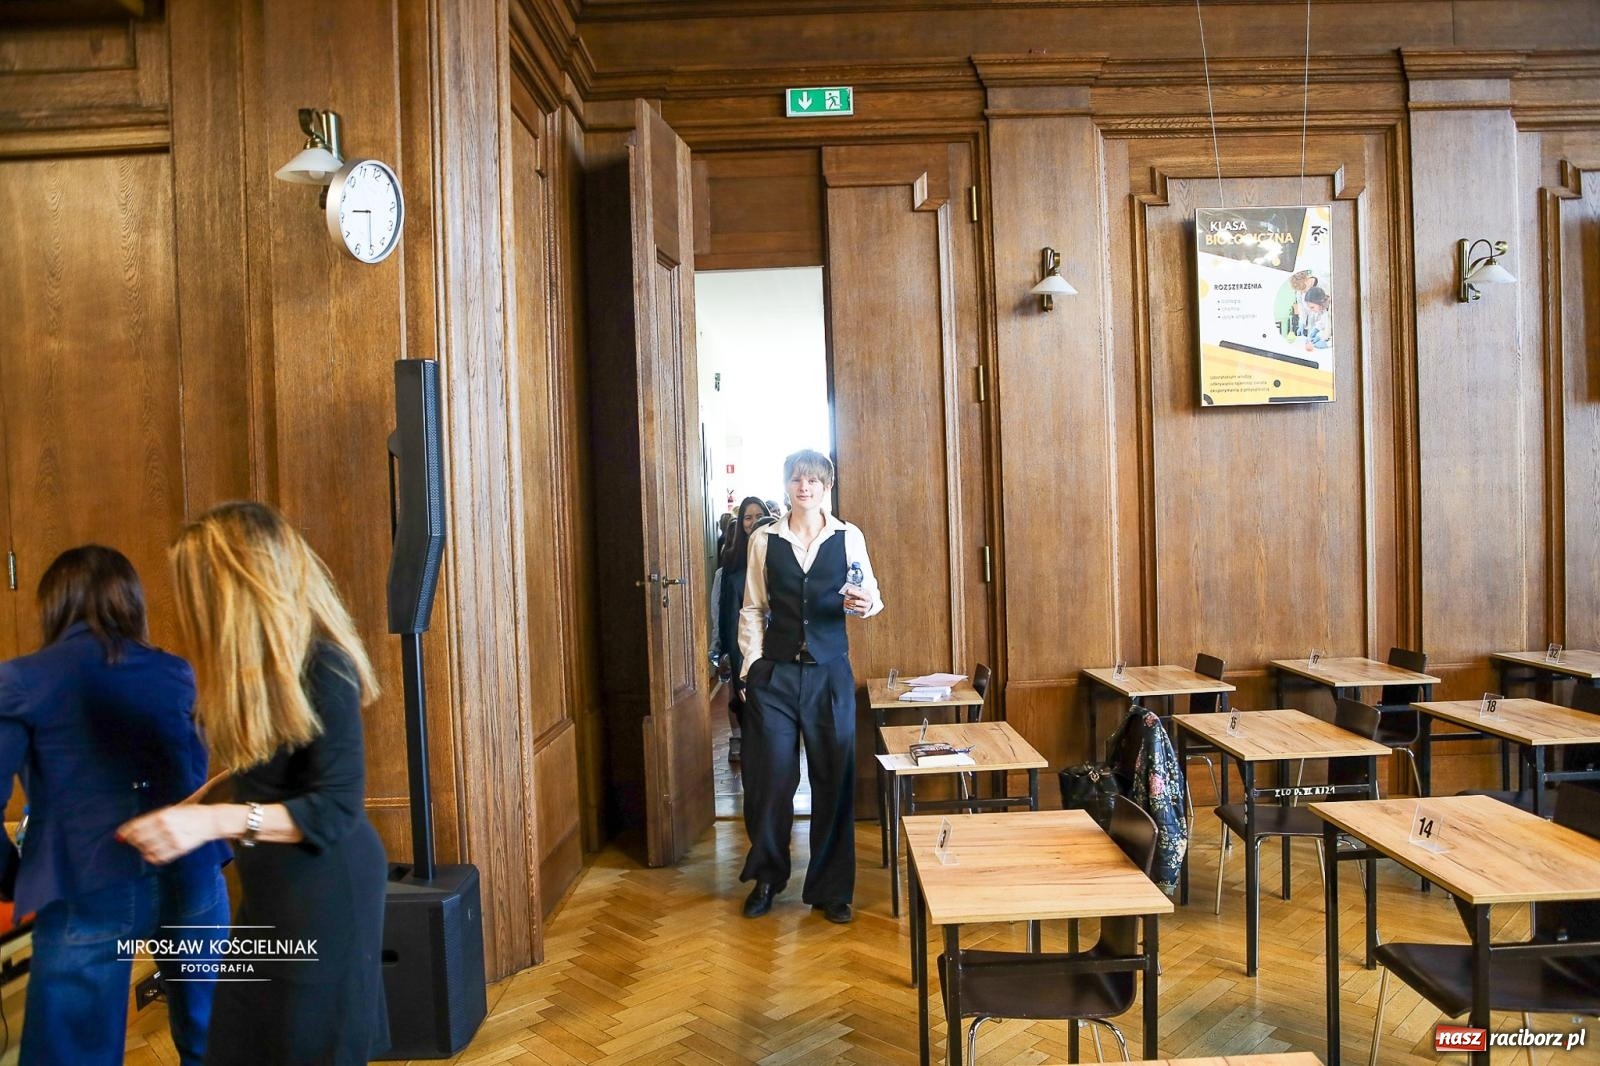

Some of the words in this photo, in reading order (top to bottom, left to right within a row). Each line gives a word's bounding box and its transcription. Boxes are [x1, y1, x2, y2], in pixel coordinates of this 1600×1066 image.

[360, 166, 367, 178] 11
[374, 168, 382, 182] 12
[389, 201, 396, 213] 2
[388, 220, 394, 231] 3
[1210, 220, 1248, 231] KLASA
[354, 243, 361, 255] 6
[368, 244, 375, 256] 5
[1213, 282, 1263, 291] ROZSZERZENIA
[1313, 654, 1320, 665] 17
[1486, 699, 1497, 713] 18
[1230, 716, 1238, 730] 15
[1418, 817, 1434, 839] 14
